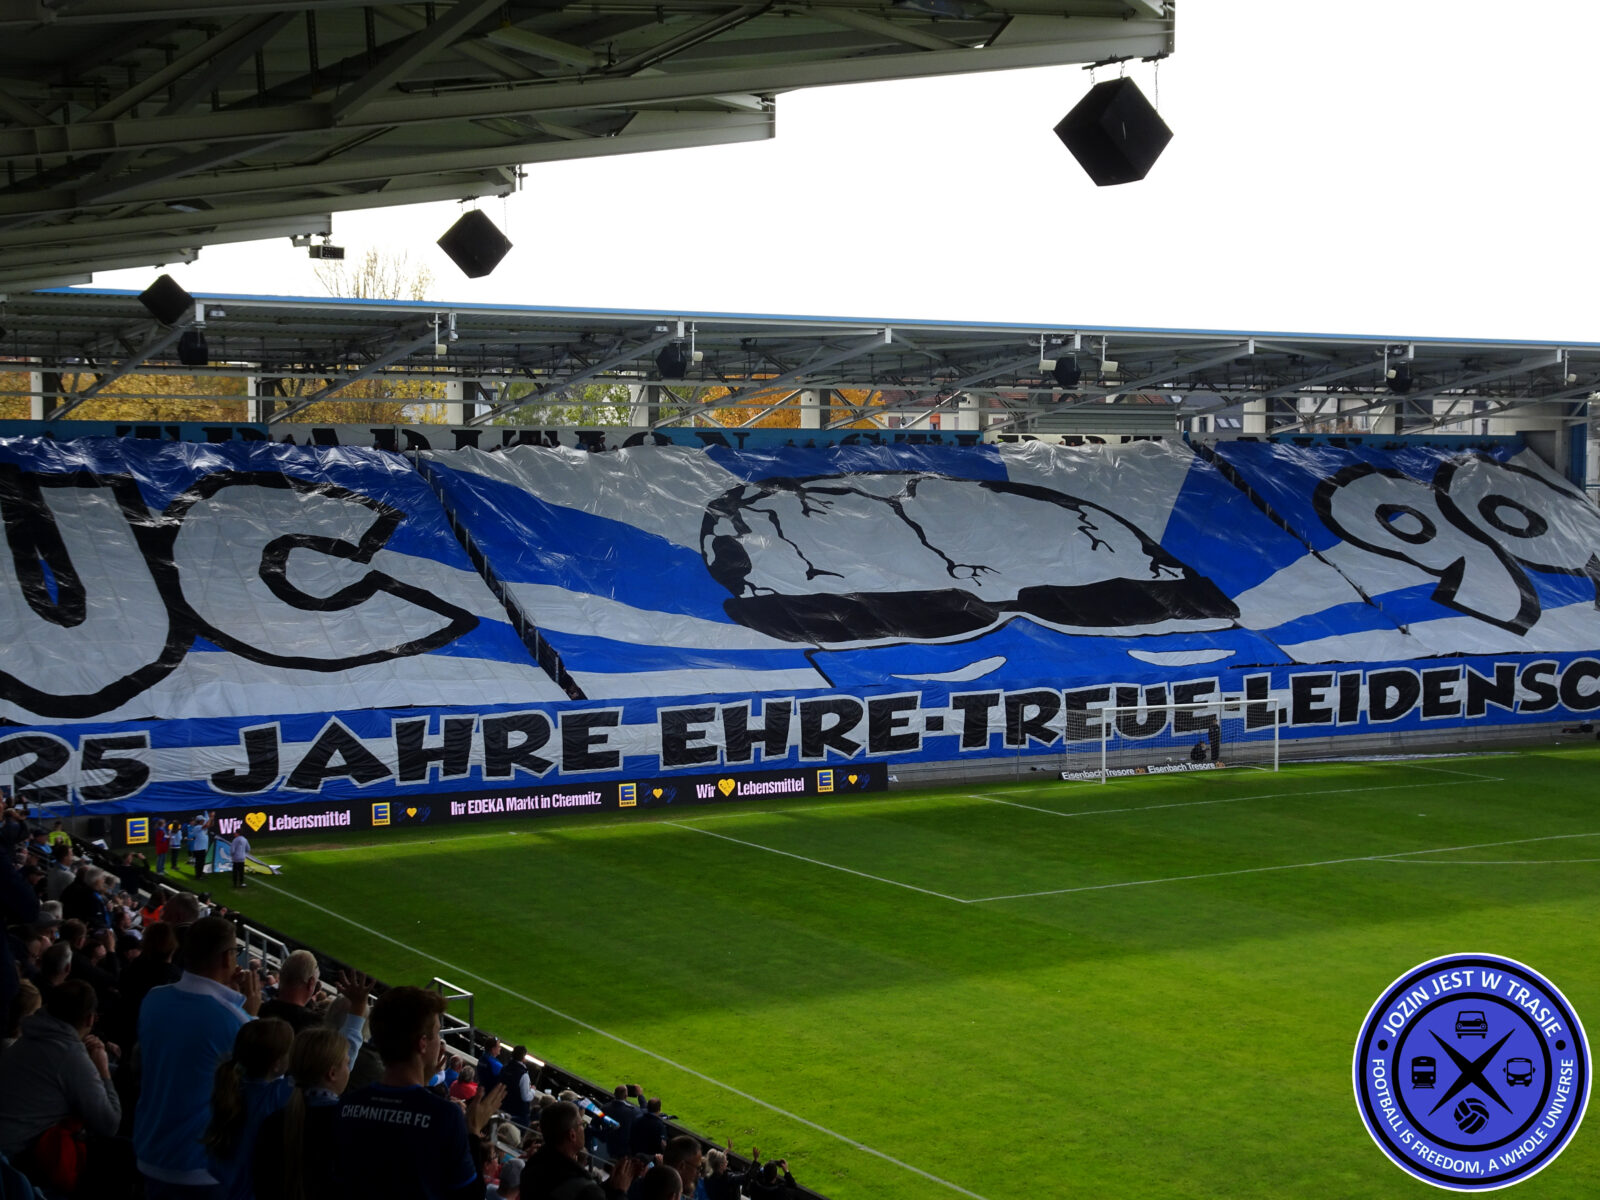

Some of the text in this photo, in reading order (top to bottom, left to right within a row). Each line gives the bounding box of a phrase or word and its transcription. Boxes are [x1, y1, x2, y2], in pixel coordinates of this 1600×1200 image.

[0, 732, 150, 804] 25
[208, 706, 624, 795] JAHRE
[696, 784, 716, 799] Wir
[737, 777, 805, 796] Lebensmittel
[450, 801, 466, 816] Ihr
[467, 797, 504, 814] EDEKA
[506, 794, 539, 811] Markt
[541, 794, 551, 809] in
[552, 790, 602, 808] Chemnitz
[268, 810, 351, 832] Lebensmittel
[340, 1104, 432, 1128] CHEMNITZER FC
